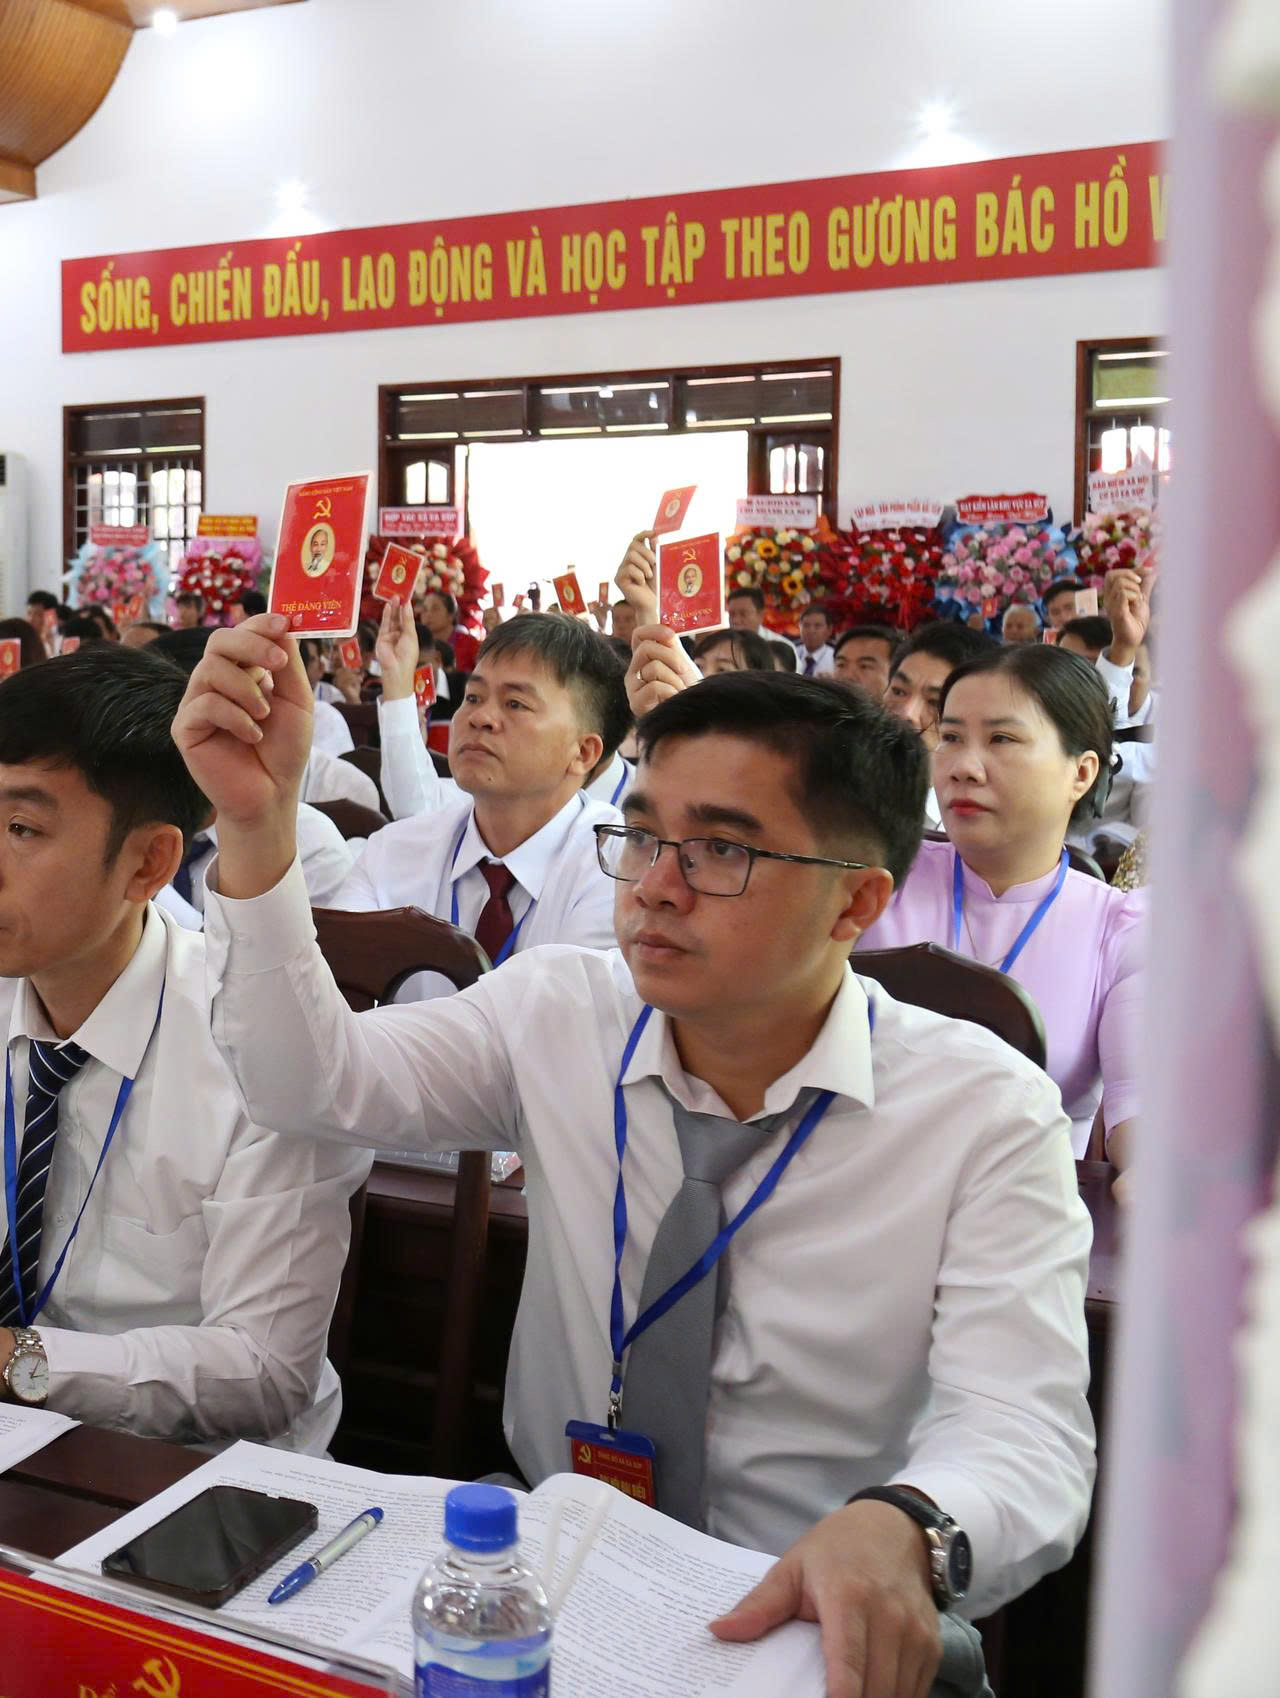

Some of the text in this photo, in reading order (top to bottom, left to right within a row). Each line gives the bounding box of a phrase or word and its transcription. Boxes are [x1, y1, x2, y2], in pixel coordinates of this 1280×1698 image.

[81, 263, 160, 334] SỐNG,
[170, 250, 253, 327] CHIẾN
[264, 240, 330, 321] ĐẤU,
[342, 252, 397, 313] LAO
[409, 236, 494, 317] ĐỘNG
[506, 226, 549, 298] VÀ
[561, 229, 628, 305] HỌC
[642, 212, 706, 299] TẬP
[721, 211, 812, 281] THEO
[828, 194, 958, 272] GƯƠNG
[976, 175, 1056, 258] BÁC
[1075, 154, 1131, 249] HỒ
